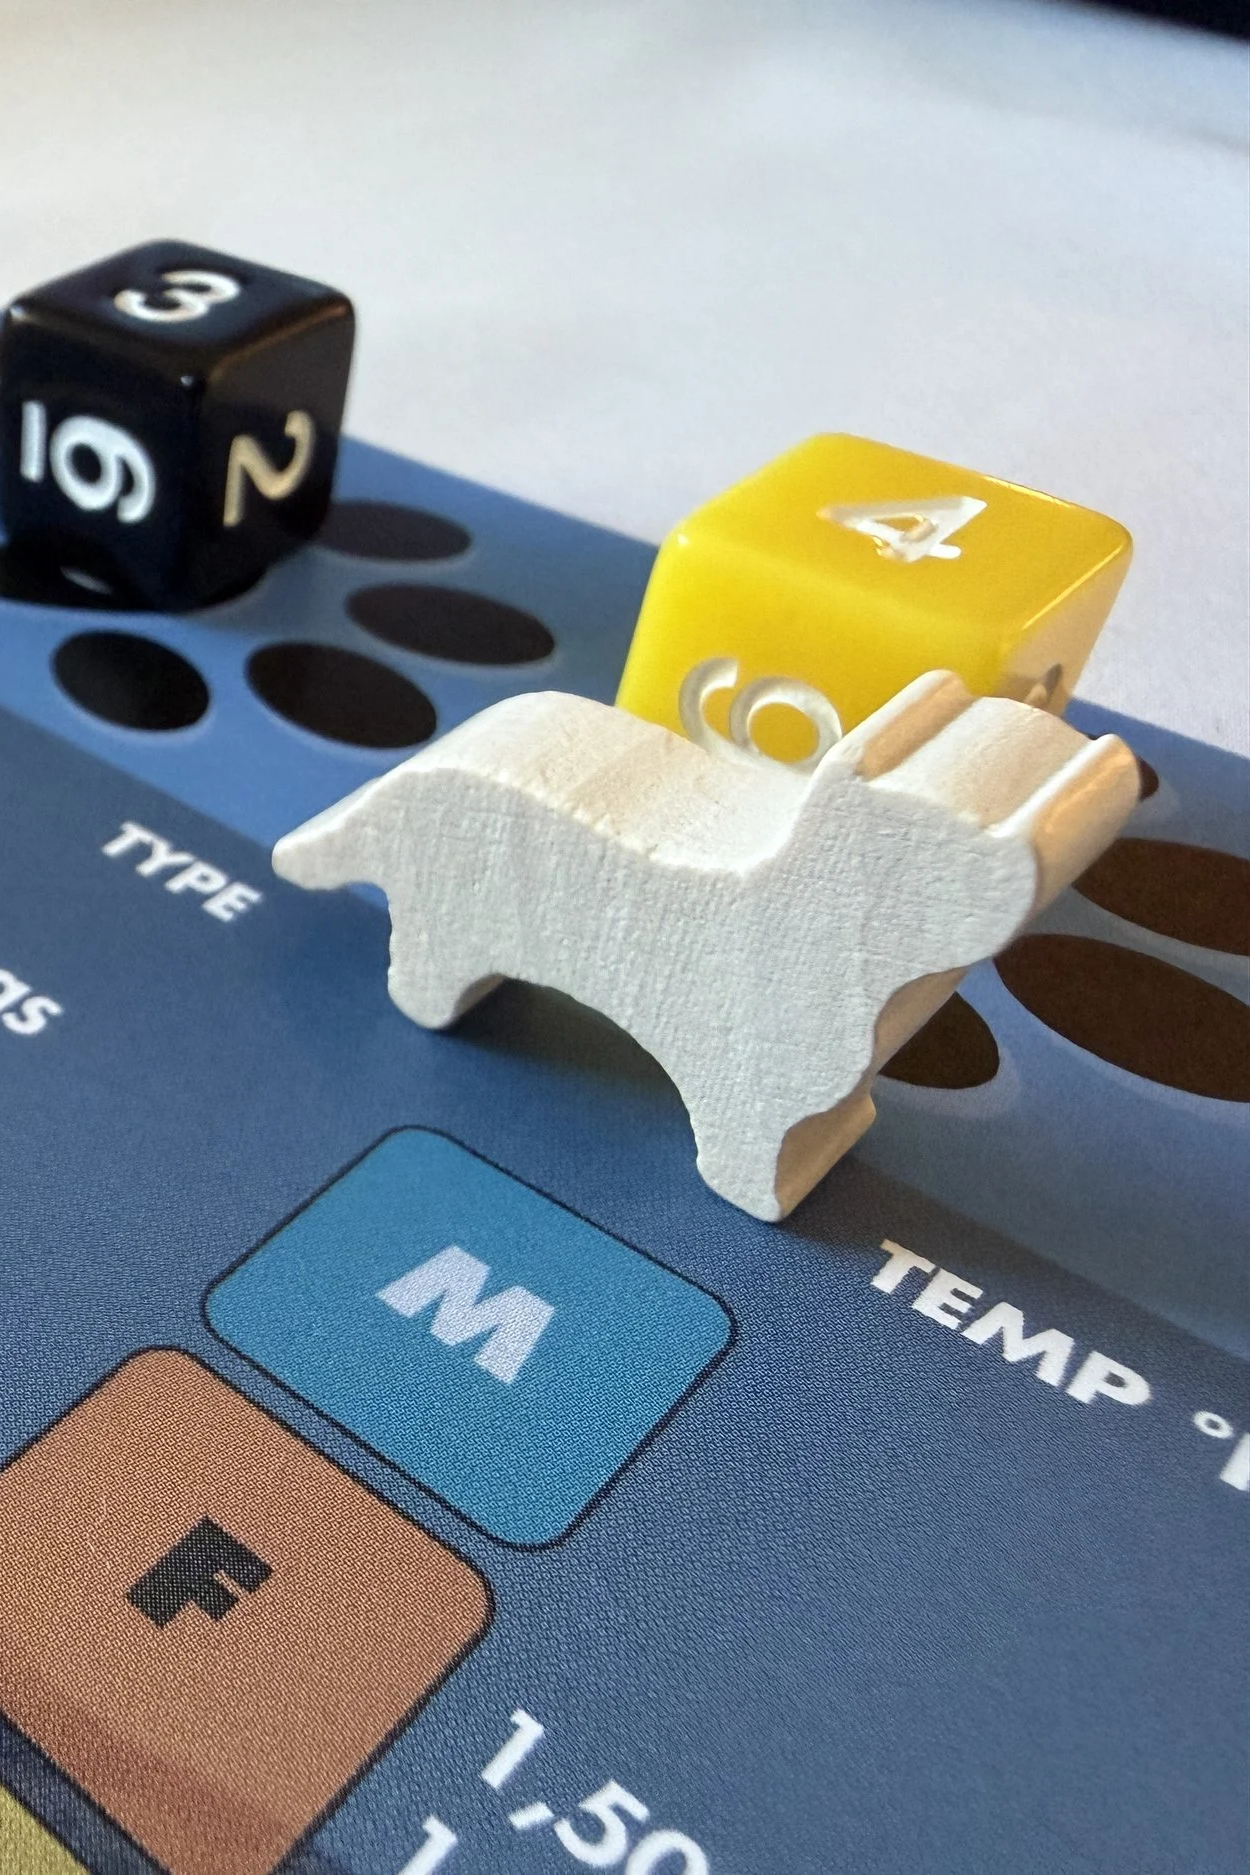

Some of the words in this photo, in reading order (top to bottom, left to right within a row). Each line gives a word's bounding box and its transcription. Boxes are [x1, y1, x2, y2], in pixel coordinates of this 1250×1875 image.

[114, 270, 242, 325] 3
[50, 416, 157, 525] 6
[223, 410, 316, 527] 2
[819, 495, 989, 564] 4
[102, 821, 263, 924] TYPE
[376, 1245, 556, 1386] M
[870, 1239, 1154, 1407] TEMP
[126, 1517, 275, 1629] F
